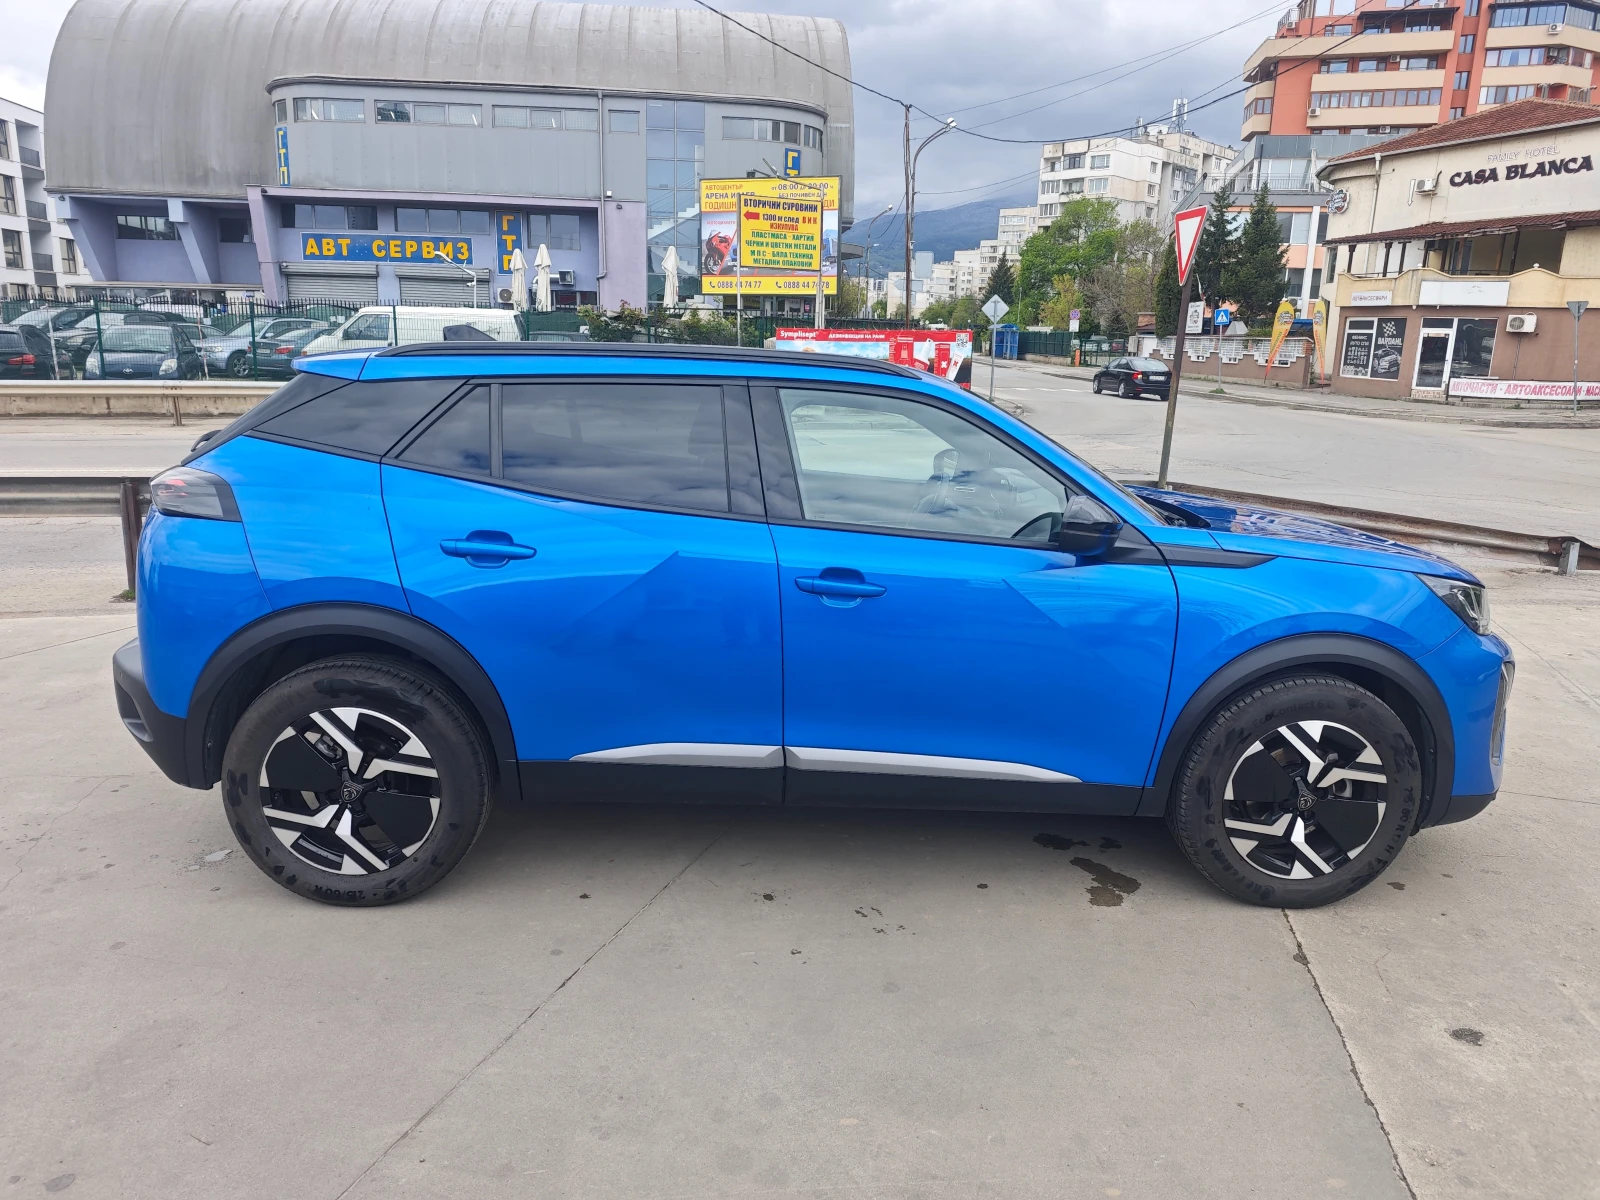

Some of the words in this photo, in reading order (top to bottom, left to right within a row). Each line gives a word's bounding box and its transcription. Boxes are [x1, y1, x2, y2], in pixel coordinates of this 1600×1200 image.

[278, 130, 290, 185] ГТП
[1487, 151, 1521, 164] FAMILY
[1524, 145, 1561, 159] HOTEL
[1449, 167, 1499, 187] CASA
[1505, 155, 1594, 181] BLANCA
[705, 184, 743, 192] АВТОЦЕНТЪР
[778, 183, 798, 191] 08:00
[743, 198, 781, 211] ВТОРИЧНИ
[782, 201, 818, 213] СУРОВИНИ
[762, 214, 777, 222] 1300
[769, 222, 799, 231] ИЗКУПУВА
[751, 231, 788, 240] ПЛАСТМАСА
[792, 234, 815, 242] ХАРТИЯ
[305, 238, 351, 256] АВТ
[372, 239, 469, 261] СЕРВИЗ
[745, 240, 765, 248] ЧЕРНИ
[770, 242, 793, 250] ЦВЕТНИ
[793, 243, 817, 251] МЕТАЛИ
[772, 251, 788, 259] БЯЛА
[788, 252, 814, 260] ТЕХНИКА
[752, 257, 781, 266] МЕТАЛНИ
[717, 281, 734, 289] 0888
[743, 281, 753, 289] 74
[753, 281, 762, 289] 77
[783, 281, 800, 289] 0888
[802, 281, 811, 289] 44
[1377, 337, 1403, 346] BARDAHL
[1450, 381, 1499, 395] АВТОЧАСТИ
